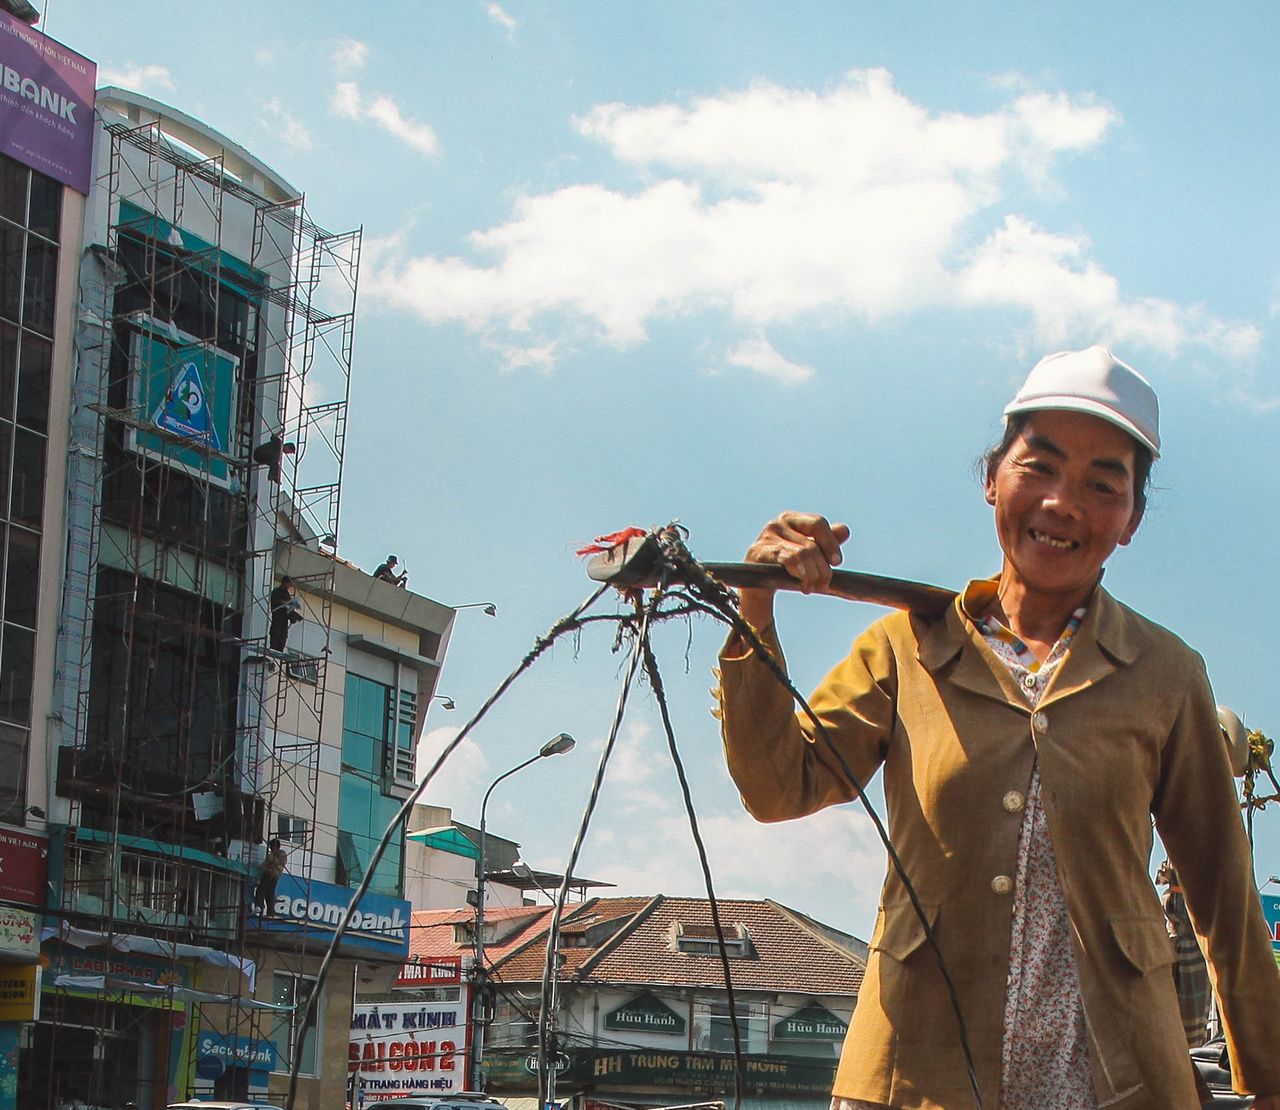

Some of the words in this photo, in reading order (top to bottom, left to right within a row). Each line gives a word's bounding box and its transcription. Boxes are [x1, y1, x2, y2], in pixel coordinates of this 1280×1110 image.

[19, 31, 38, 49] NÔNG
[38, 42, 57, 60] THÔN
[57, 52, 72, 67] VIỆT
[71, 61, 87, 76] NAM
[35, 111, 57, 131] khách
[57, 123, 75, 140] hàng
[252, 884, 407, 939] acombank
[401, 1006, 458, 1030] KÍNH
[201, 1038, 272, 1063] Sacombank
[348, 1033, 387, 1074] SÀI
[388, 1031, 437, 1074] GÒN
[438, 1041, 457, 1072] 2
[593, 1055, 622, 1077] HH
[629, 1053, 680, 1069] TRUNG
[368, 1078, 401, 1090] TRANG
[402, 1076, 430, 1090] HÀNG
[430, 1076, 453, 1092] HIỆU
